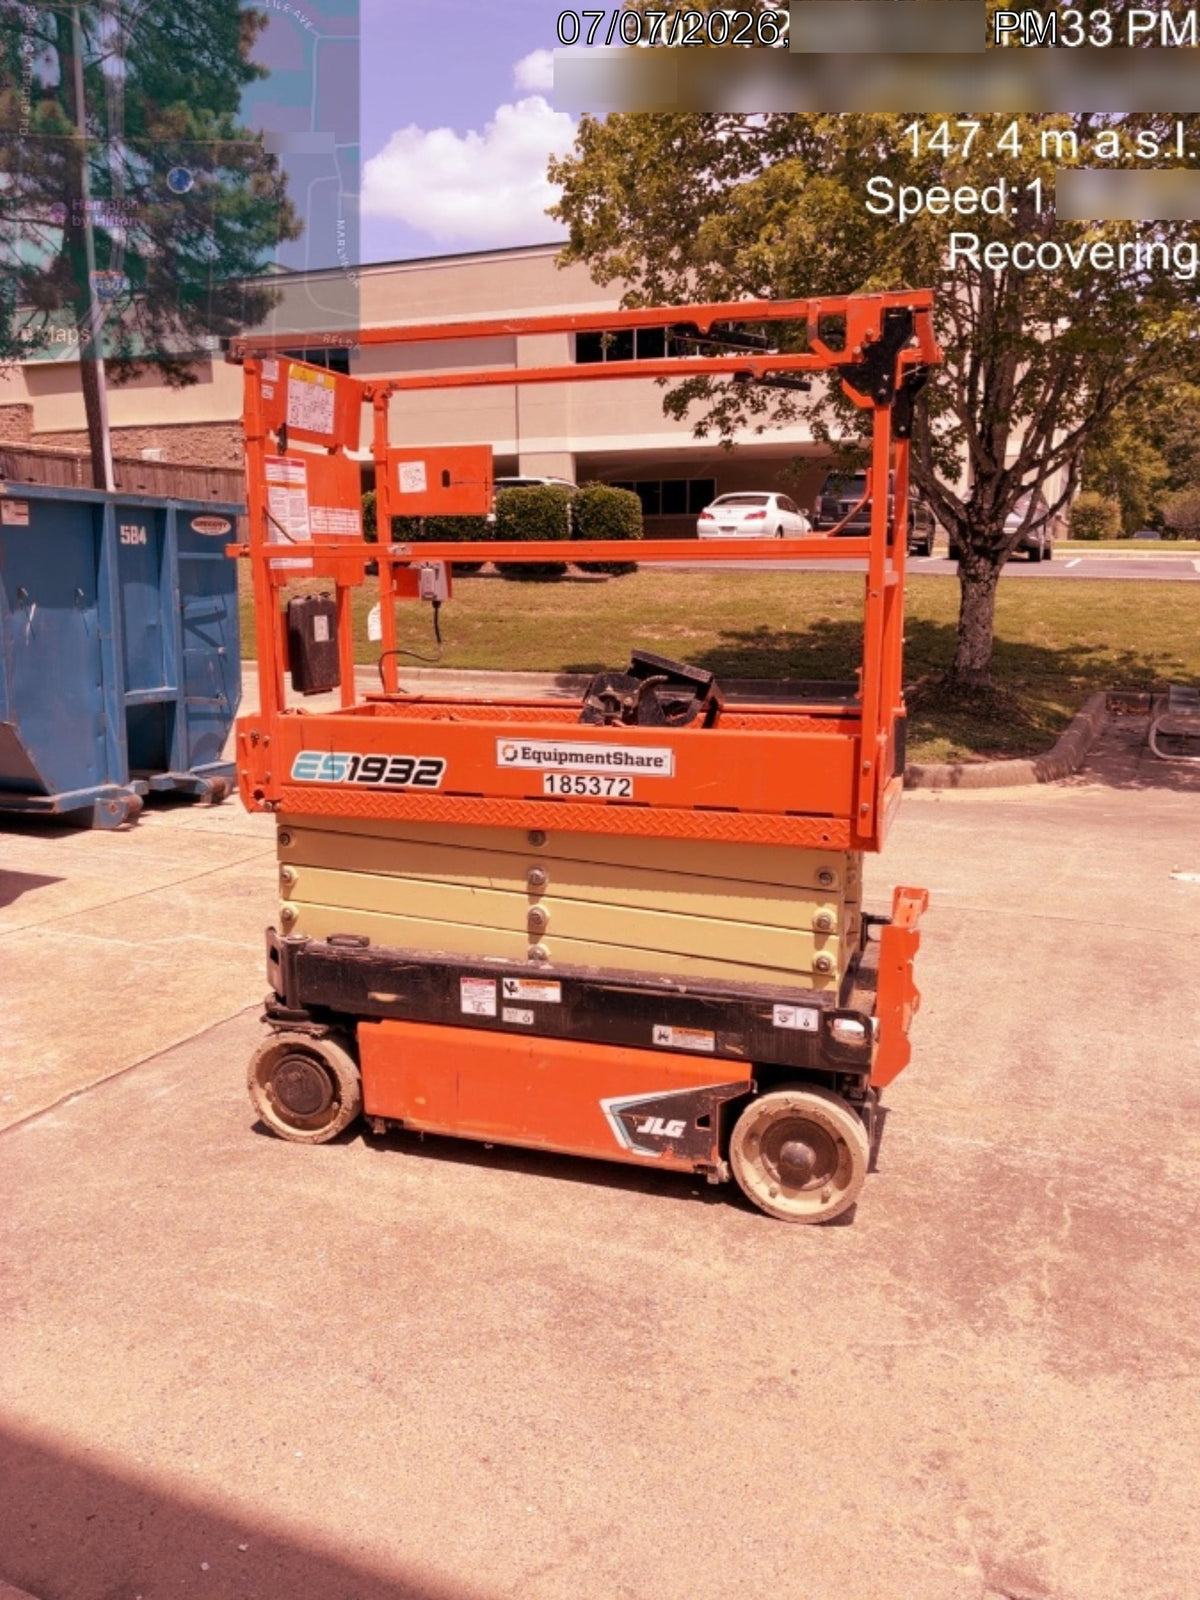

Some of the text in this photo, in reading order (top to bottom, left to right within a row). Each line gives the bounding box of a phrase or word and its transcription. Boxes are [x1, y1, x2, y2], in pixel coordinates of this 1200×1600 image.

[520, 746, 665, 770] EquipmentShare
[292, 752, 446, 788] ES1932
[544, 775, 632, 797] 185372
[636, 1116, 688, 1139] JLG
